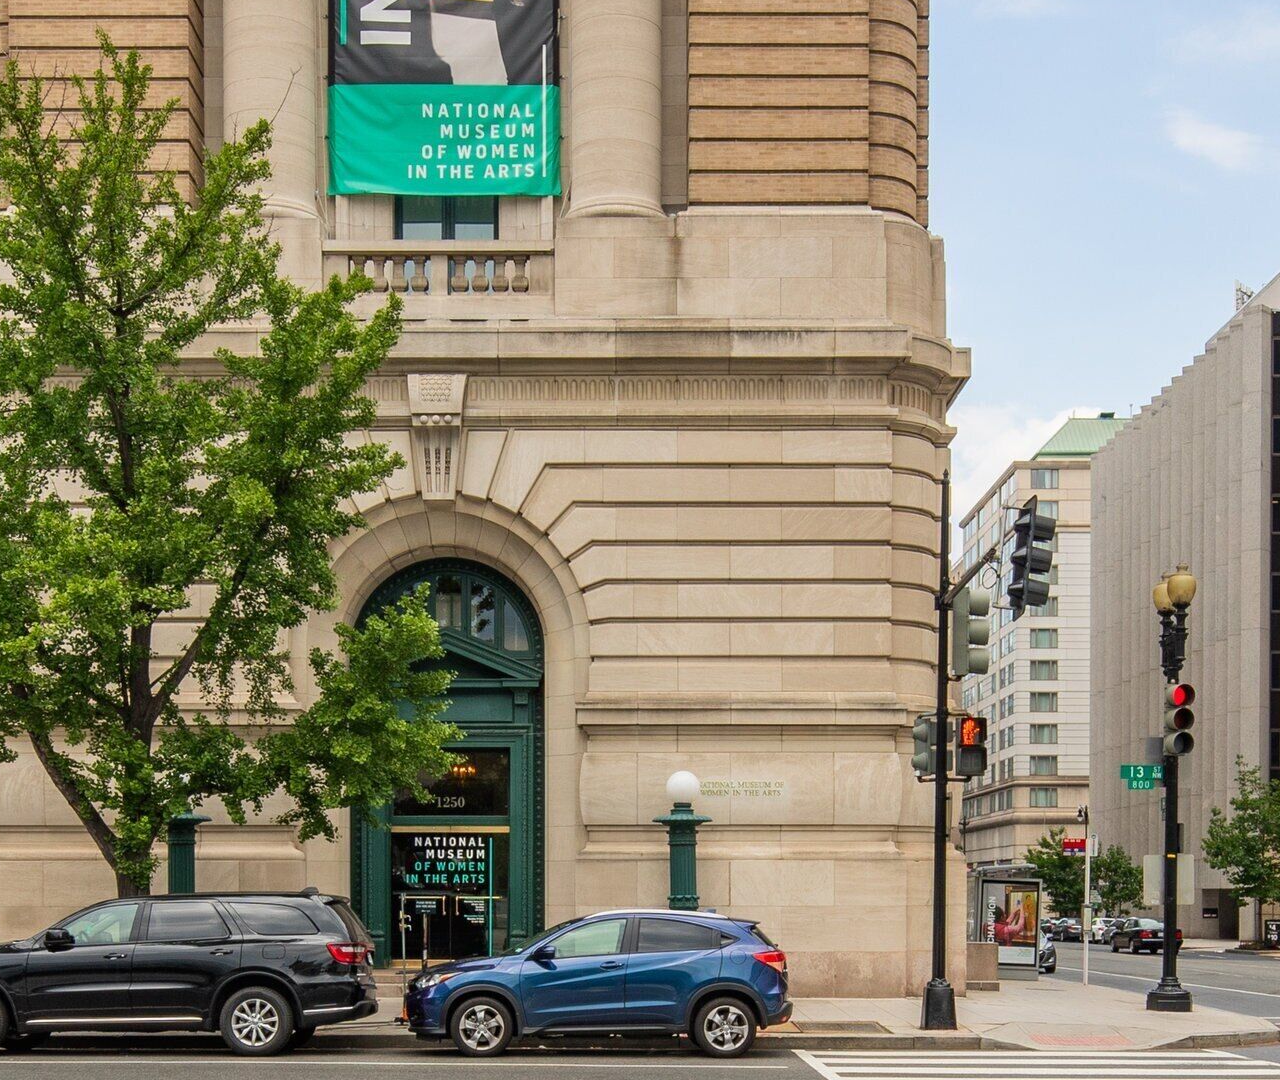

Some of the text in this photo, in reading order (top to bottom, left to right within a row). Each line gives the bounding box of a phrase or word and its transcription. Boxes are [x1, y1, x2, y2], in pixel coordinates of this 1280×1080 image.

[422, 103, 535, 118] NATIONAL
[440, 123, 535, 139] MUSEUM
[421, 143, 535, 160] OF WOMEN
[407, 163, 535, 179] IN THE ARTS
[1130, 766, 1145, 778] 13
[738, 781, 772, 789] MUSEUM
[1132, 780, 1150, 789] 800
[732, 789, 741, 797] IN
[744, 789, 759, 797] THE
[762, 789, 781, 797] ARTS
[435, 796, 465, 808] 1250
[414, 837, 485, 847] NATIONAL
[426, 849, 485, 859] MUSEUM
[415, 861, 485, 871] OF WOMEN
[406, 874, 485, 883] IN THE ARTS
[986, 896, 997, 944] CHAMPION
